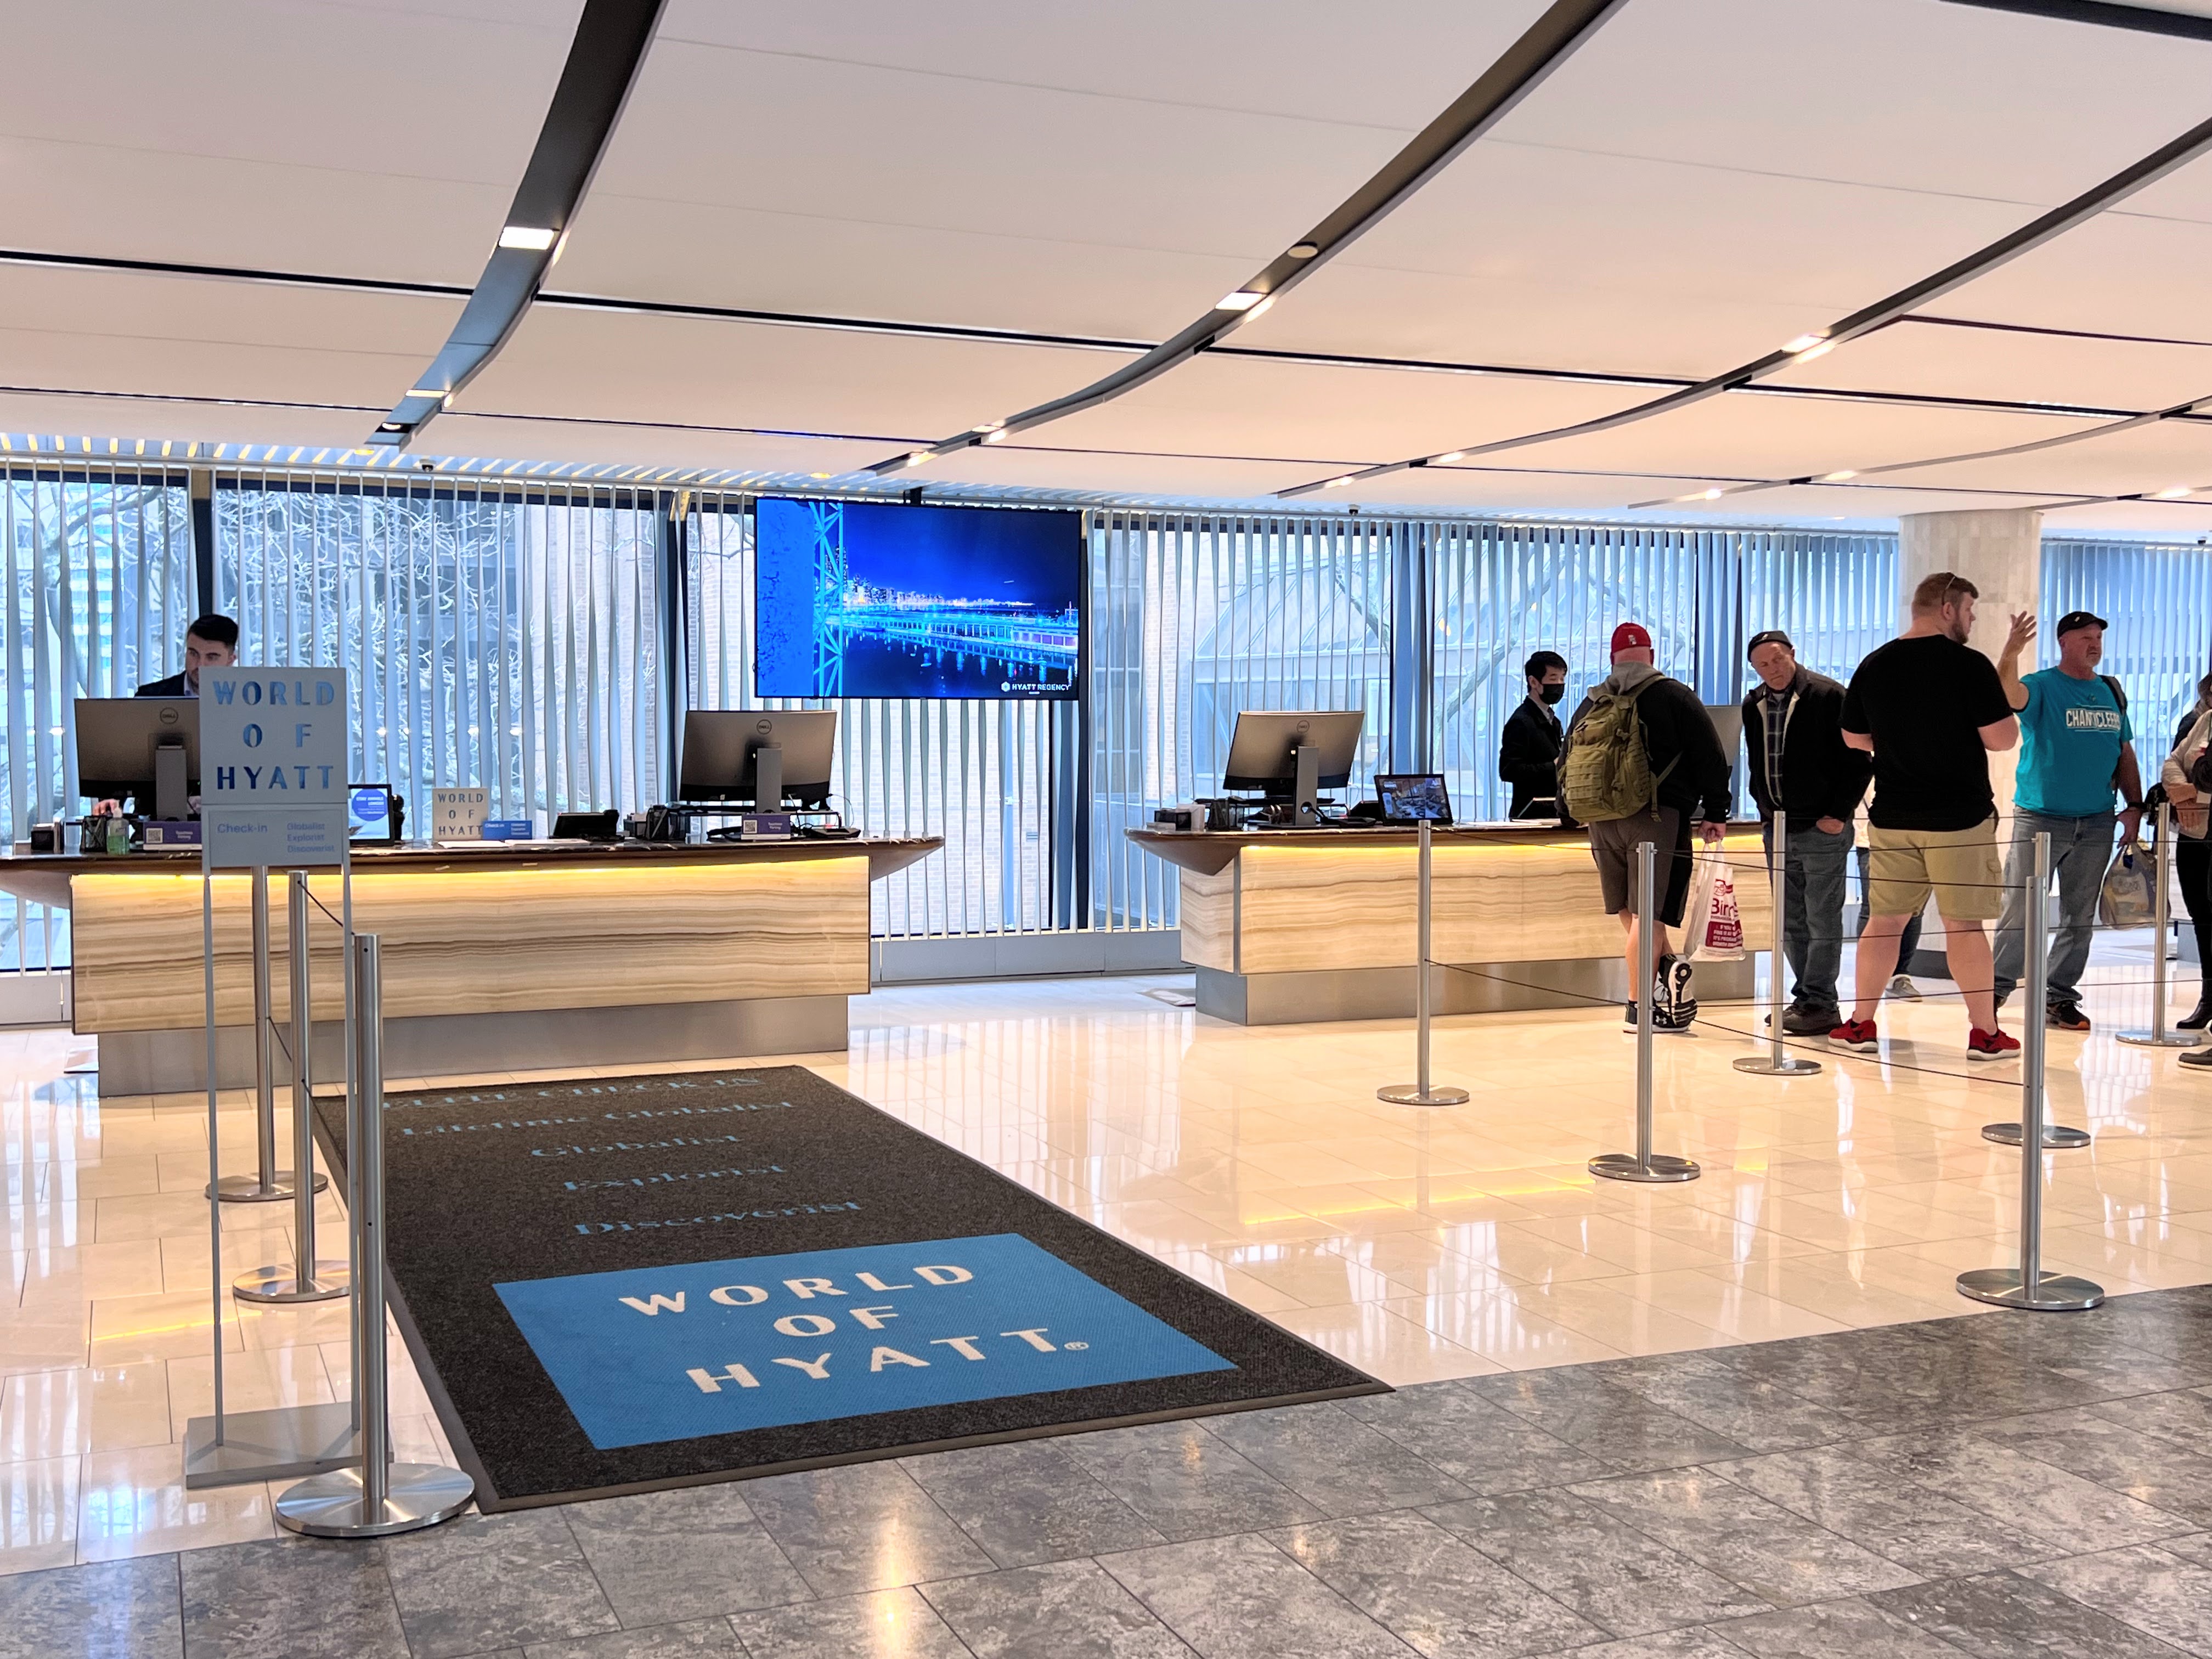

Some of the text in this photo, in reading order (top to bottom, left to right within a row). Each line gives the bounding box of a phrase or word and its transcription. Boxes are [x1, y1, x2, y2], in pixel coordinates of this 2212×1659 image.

[213, 681, 335, 706] WORLD
[217, 765, 334, 789] HYATT
[438, 793, 483, 803] WORLD
[217, 823, 268, 834] Check-in
[287, 834, 325, 842] Explorist
[438, 825, 483, 836] HYATT
[287, 845, 335, 853] Discoverist
[403, 1101, 794, 1135] Lifetime Globalist
[531, 1135, 744, 1157] Globalist
[563, 1165, 787, 1191] Explorist
[574, 1201, 861, 1235] Discoverist
[619, 1265, 974, 1316] WORLD
[774, 1305, 899, 1337] OF
